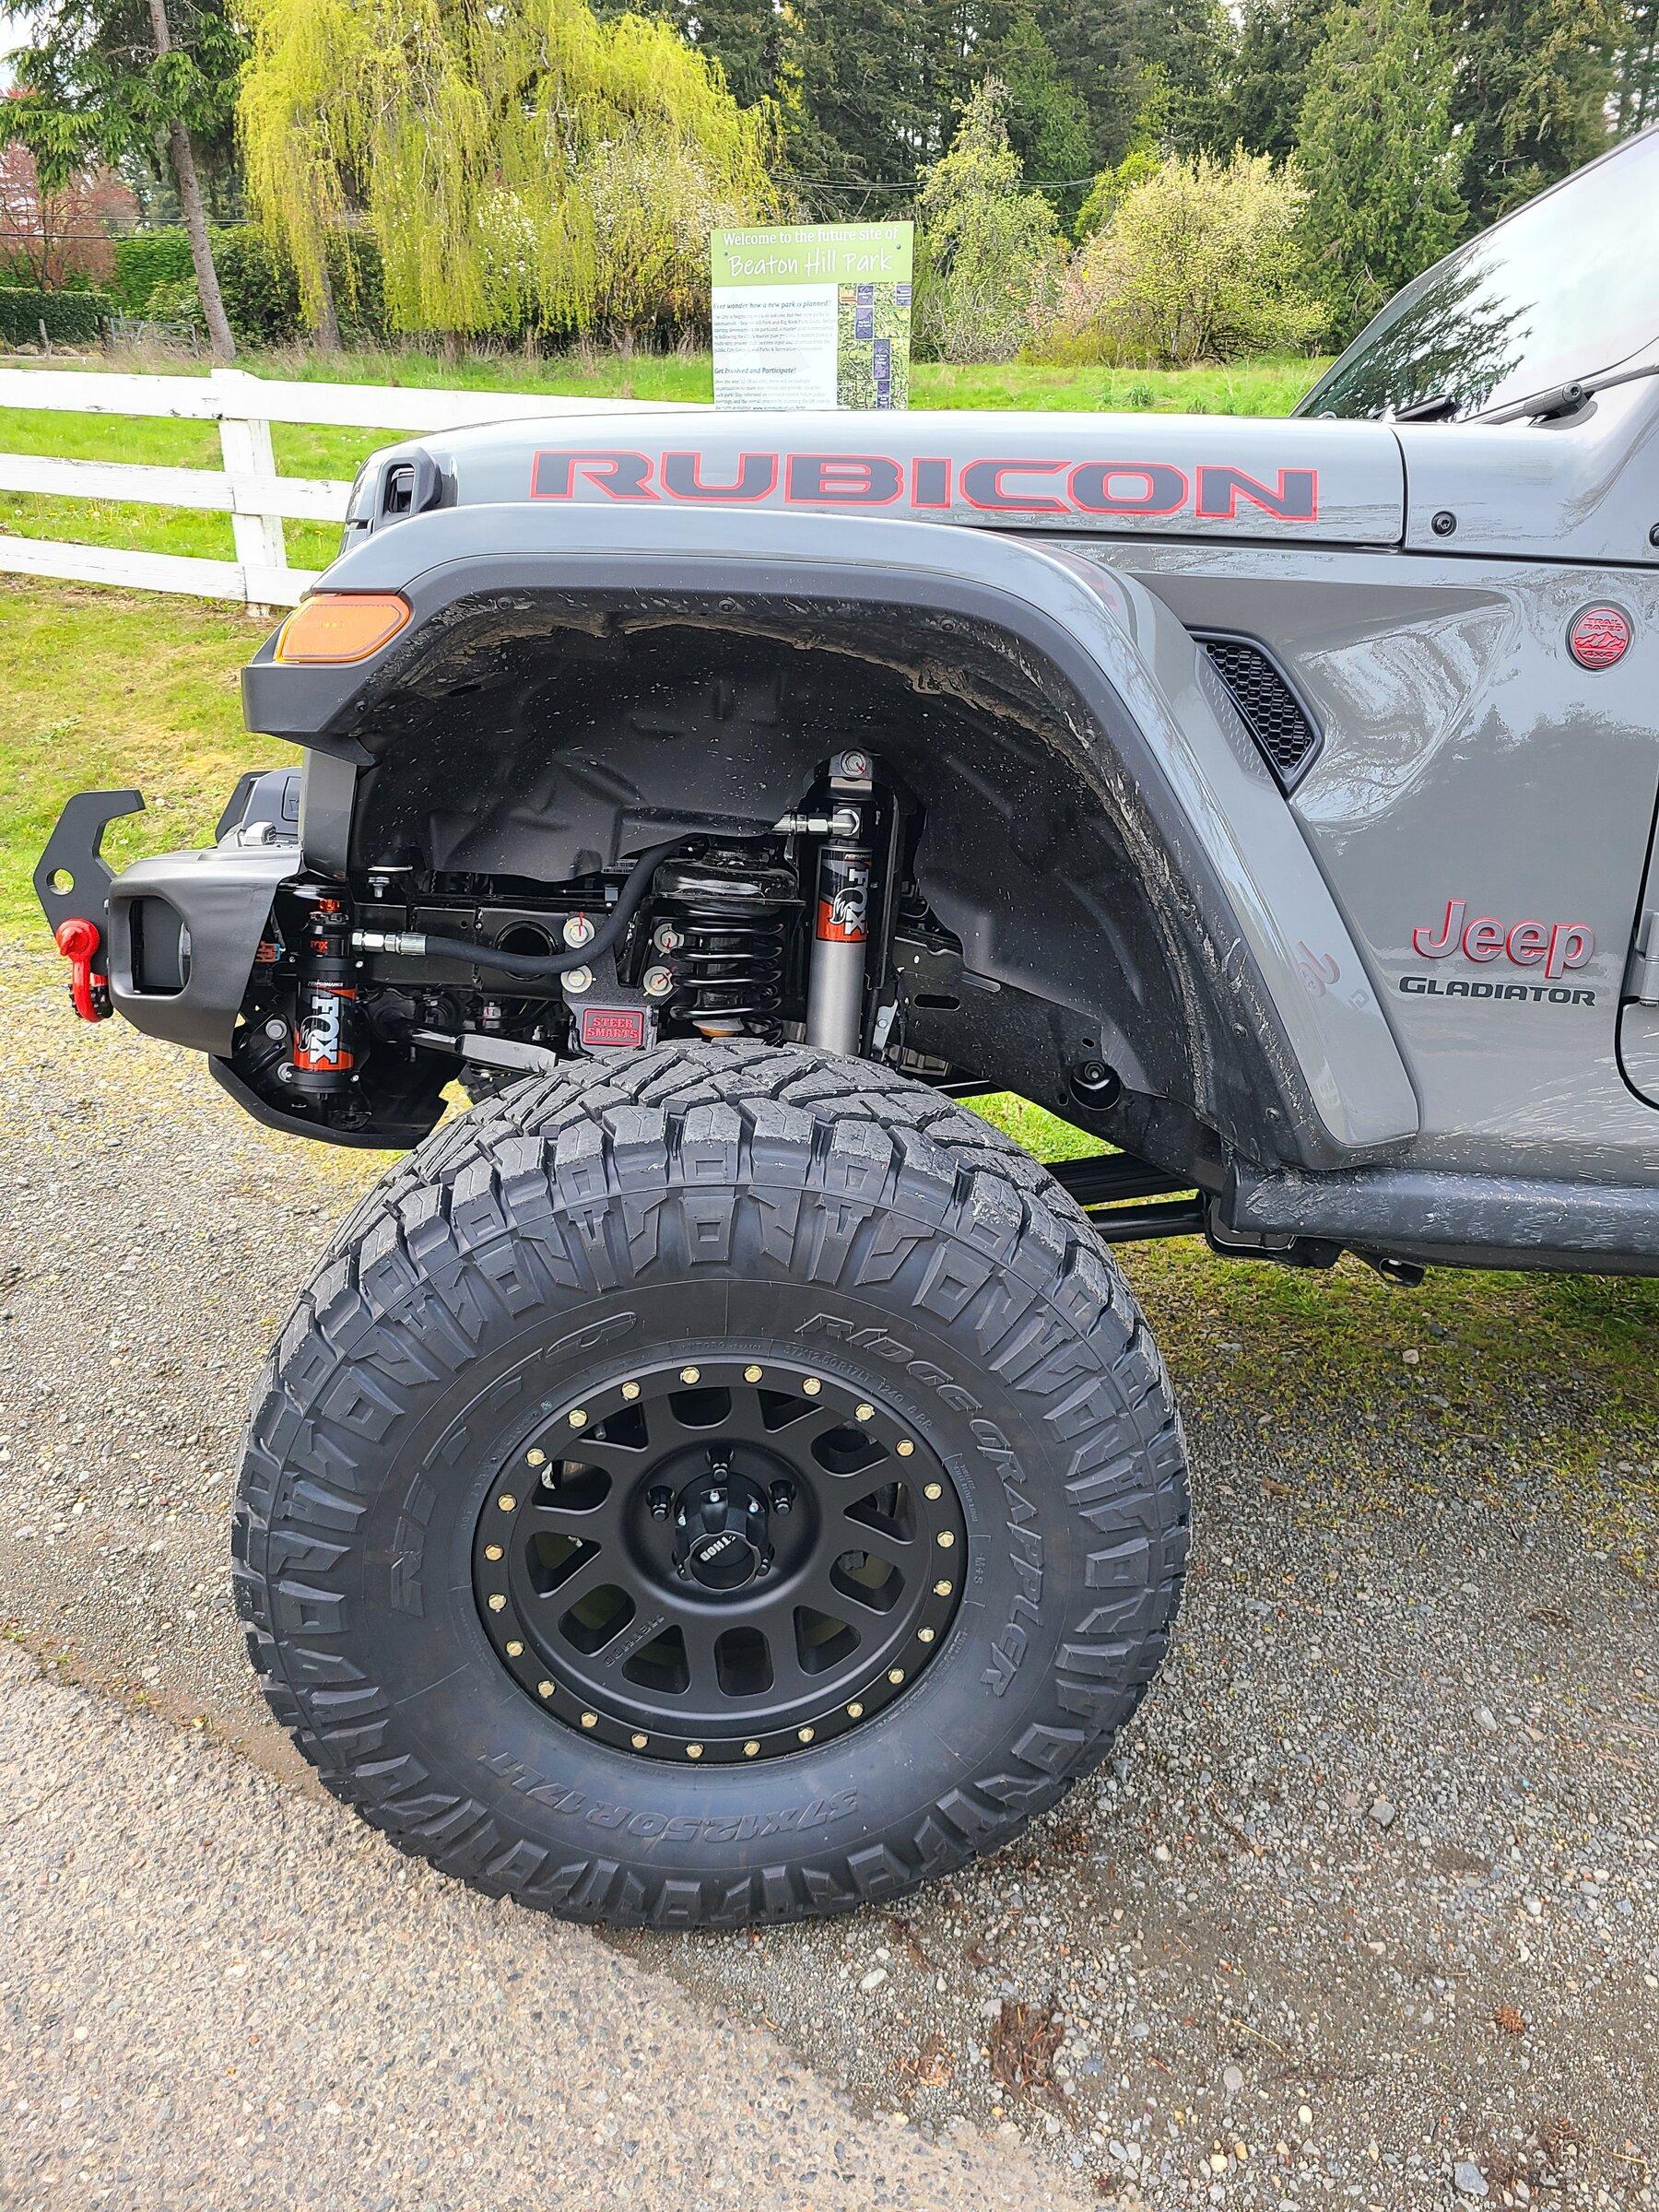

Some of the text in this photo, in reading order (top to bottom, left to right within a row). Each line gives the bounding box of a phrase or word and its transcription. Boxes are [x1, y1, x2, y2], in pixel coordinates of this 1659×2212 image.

[723, 227, 900, 246] Welcome to the future site of
[728, 247, 893, 277] Beaton Hill Park
[781, 300, 796, 310] park
[761, 367, 797, 375] Participate!
[529, 450, 1318, 522] RUBICON
[833, 868, 869, 935] FOX
[1412, 900, 1596, 980] Jeep
[1399, 976, 1596, 1006] GLADIATOR
[300, 995, 341, 1064] FOX
[587, 1027, 639, 1040] SMARTS
[593, 1017, 635, 1030] STEER
[794, 1312, 1045, 1698] RIDGE GRAPPLER
[700, 1535, 736, 1562] THOD
